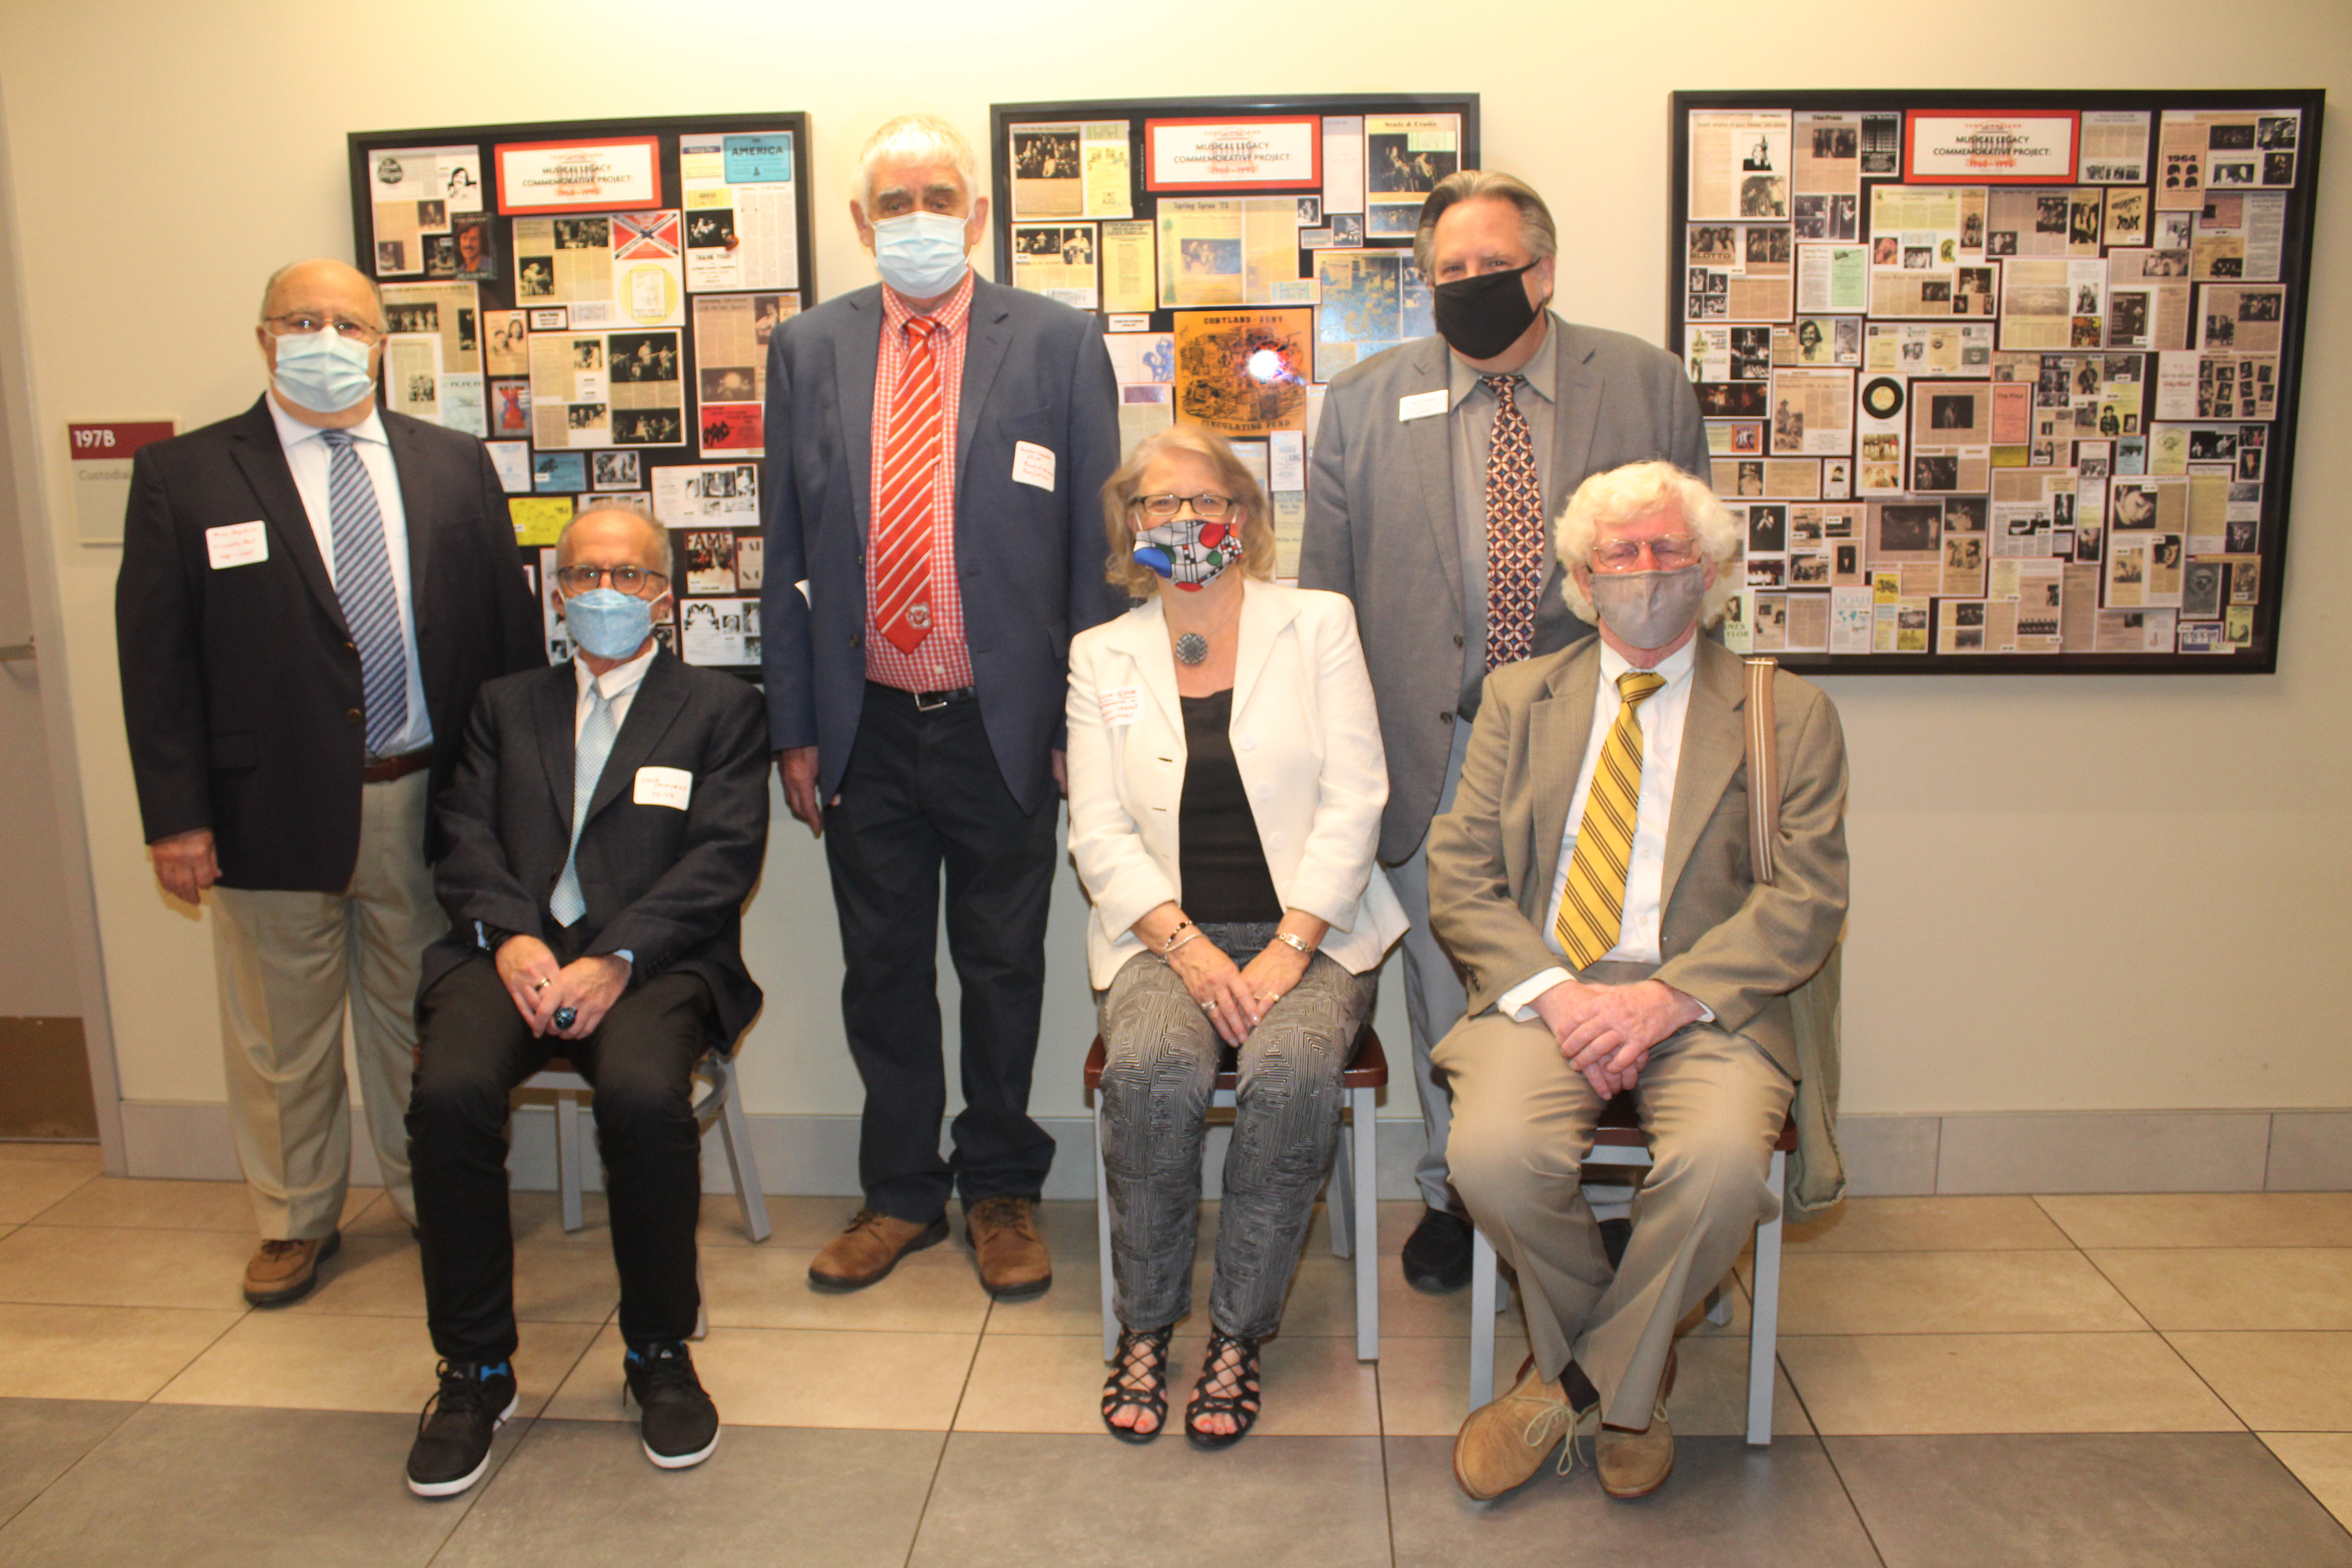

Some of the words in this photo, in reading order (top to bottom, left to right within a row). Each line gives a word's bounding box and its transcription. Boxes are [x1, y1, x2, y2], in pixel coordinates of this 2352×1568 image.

[731, 146, 784, 156] AMERICA
[1174, 154, 1251, 162] COMMEMORATIVE
[542, 166, 577, 174] MUSICAL
[580, 164, 611, 172] LEGACY
[522, 177, 595, 186] COMMEMORATIVE
[1266, 419, 1290, 429] FUND
[74, 430, 116, 447] 197B
[688, 533, 734, 549] FAME
